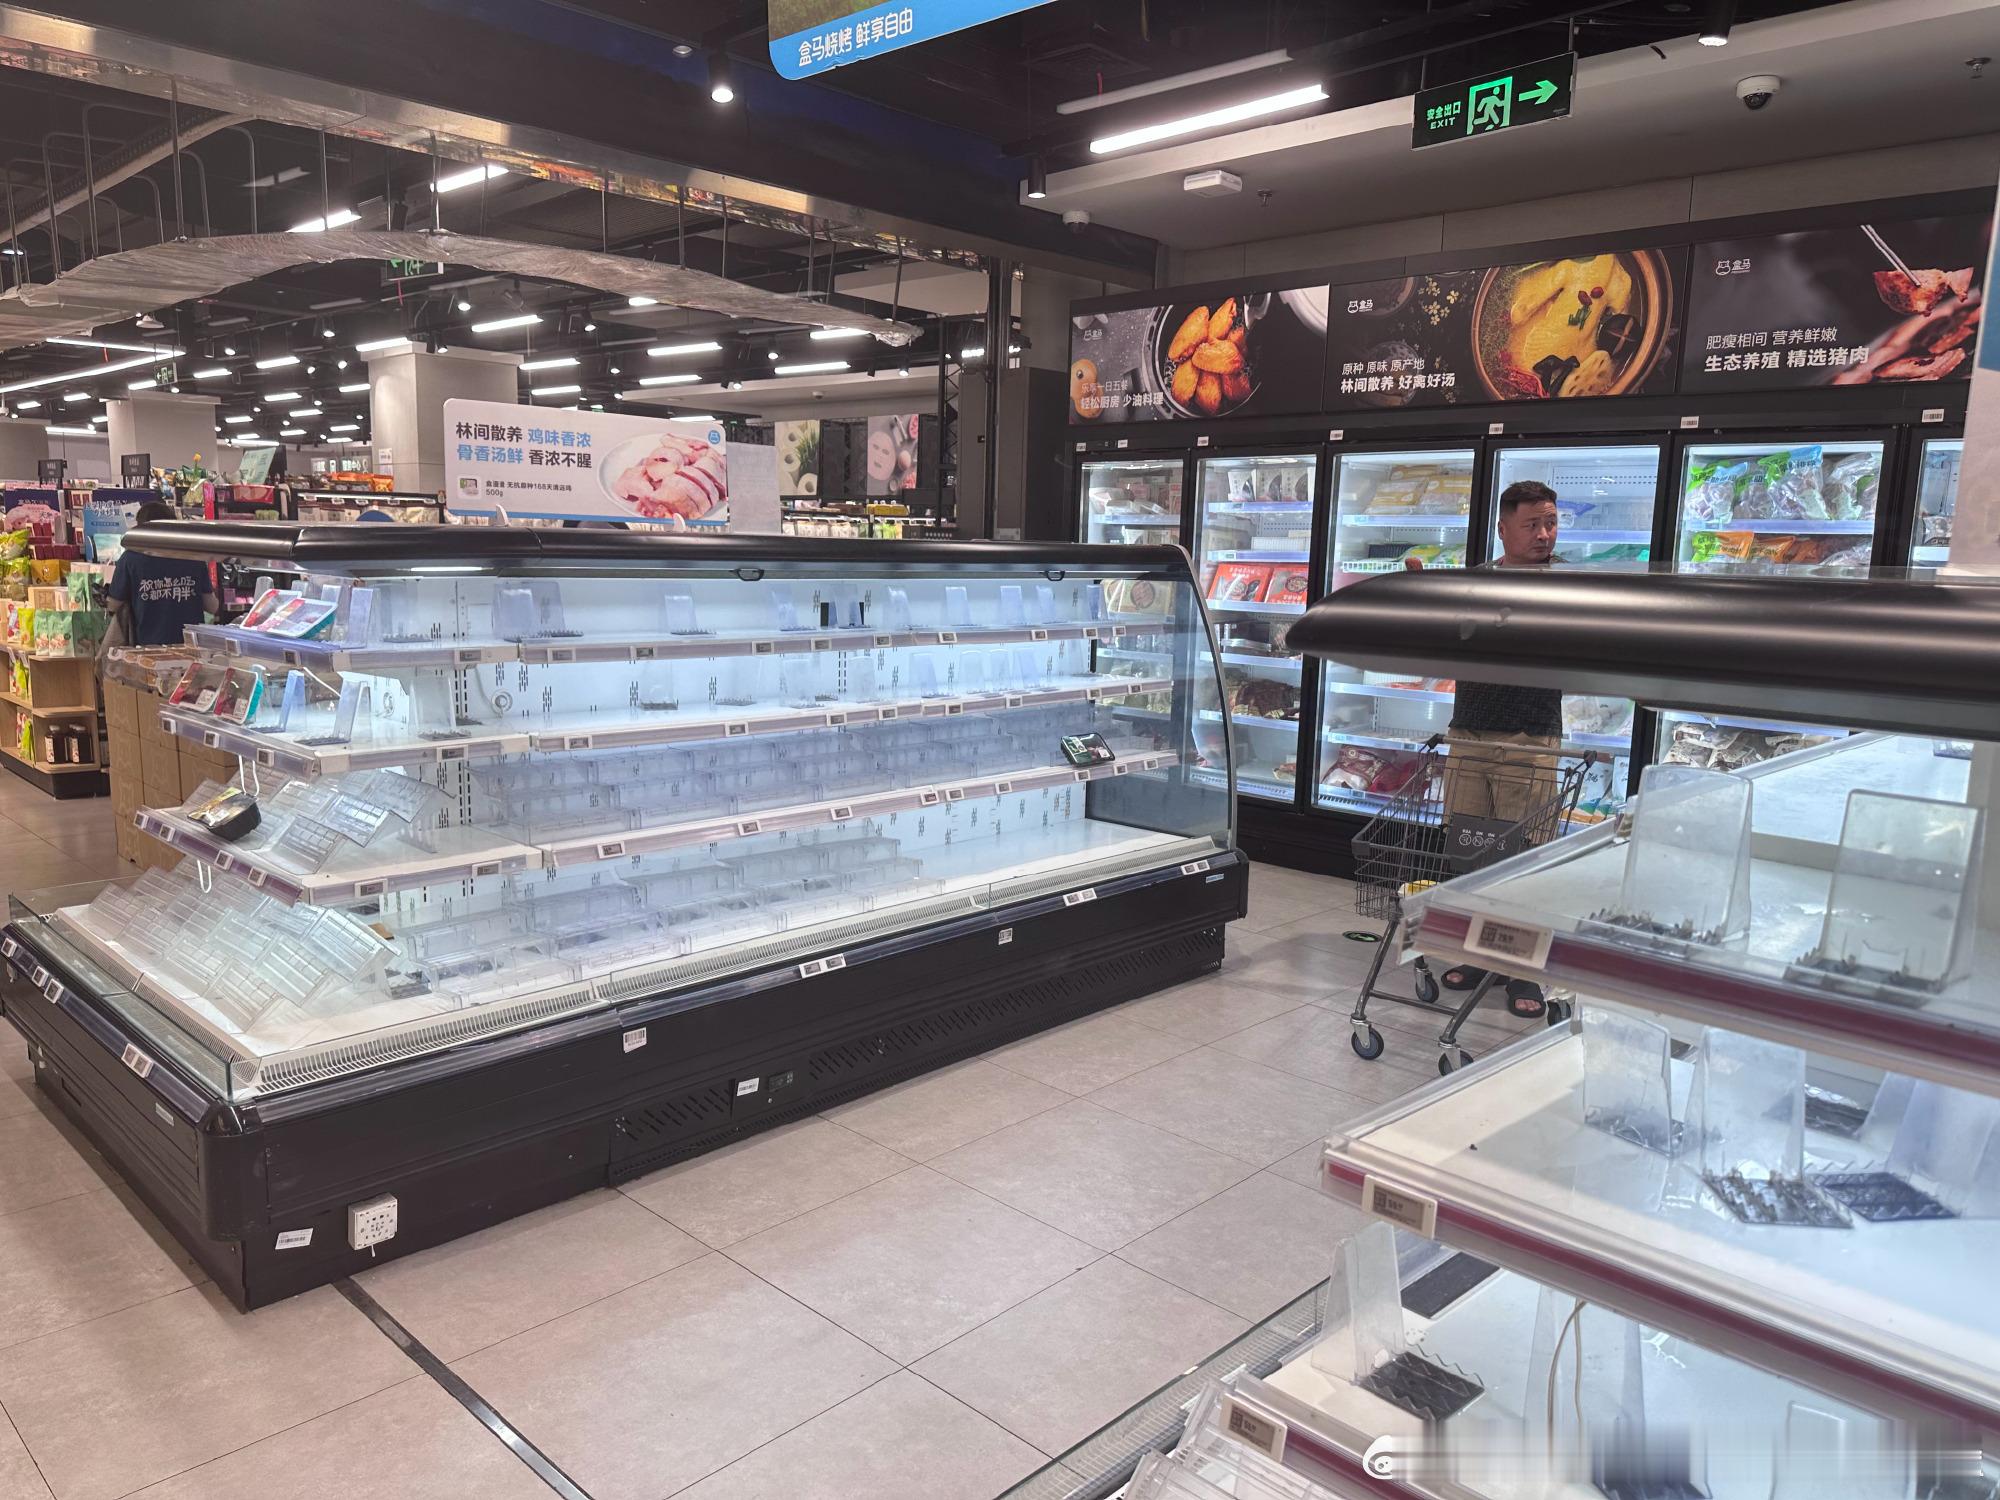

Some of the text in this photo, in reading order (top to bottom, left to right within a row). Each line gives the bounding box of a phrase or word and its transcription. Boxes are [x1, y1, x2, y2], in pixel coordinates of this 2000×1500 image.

[798, 7, 913, 67] 盒马烧烤 鲜享自由
[1427, 101, 1461, 120] 安全出口
[1430, 117, 1456, 130] EXIT
[1731, 258, 1751, 271] 盒马
[1359, 299, 1374, 309] 盒马
[1706, 326, 1838, 350] 肥瘦相间 营养鲜嫩
[1341, 357, 1425, 376] 原种 原味 原产地
[1704, 346, 1870, 372] 生态养殖 精选猪肉
[1340, 375, 1394, 394] 林间散养
[1081, 391, 1164, 410] 轻松厨房 少油料理
[456, 421, 592, 448] 林间散养 鸡味香浓
[457, 444, 592, 469] 骨香汤鲜 香浓不腥
[485, 488, 504, 498] 500g
[149, 586, 191, 602] 都不胖
